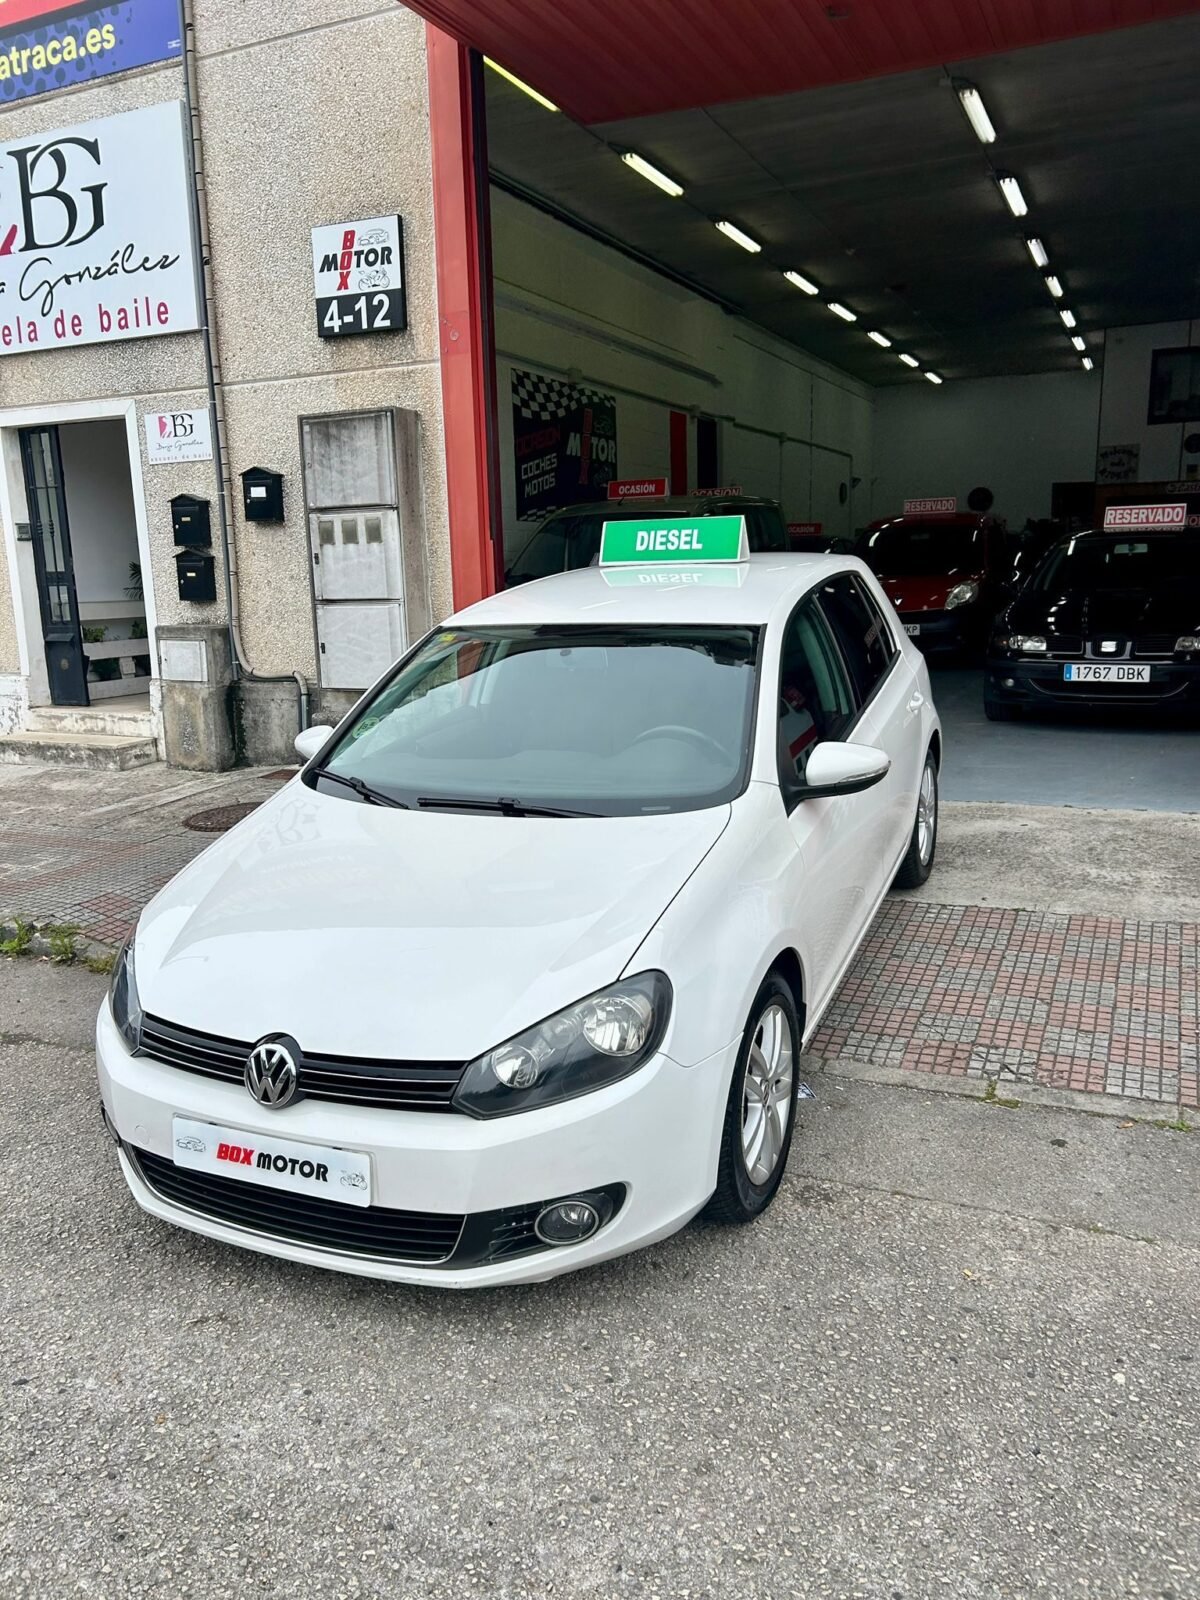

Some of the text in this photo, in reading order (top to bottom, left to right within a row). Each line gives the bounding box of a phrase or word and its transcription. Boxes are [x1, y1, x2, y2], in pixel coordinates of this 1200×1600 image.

[7, 137, 108, 252] BG
[319, 246, 392, 273] MOTOR
[20, 244, 180, 317] González
[54, 309, 82, 338] de
[99, 297, 168, 332] baile
[324, 293, 391, 333] 4-12
[522, 453, 558, 479] COCHES
[525, 472, 556, 498] MOTOS
[618, 481, 656, 495] OCASIÓN
[905, 500, 954, 513] RESERVADO
[1107, 507, 1183, 524] RESERVADO
[636, 529, 704, 551] DIESEL
[1076, 666, 1145, 680] 1767 DBK
[216, 1142, 328, 1182] BOX MOTOR
